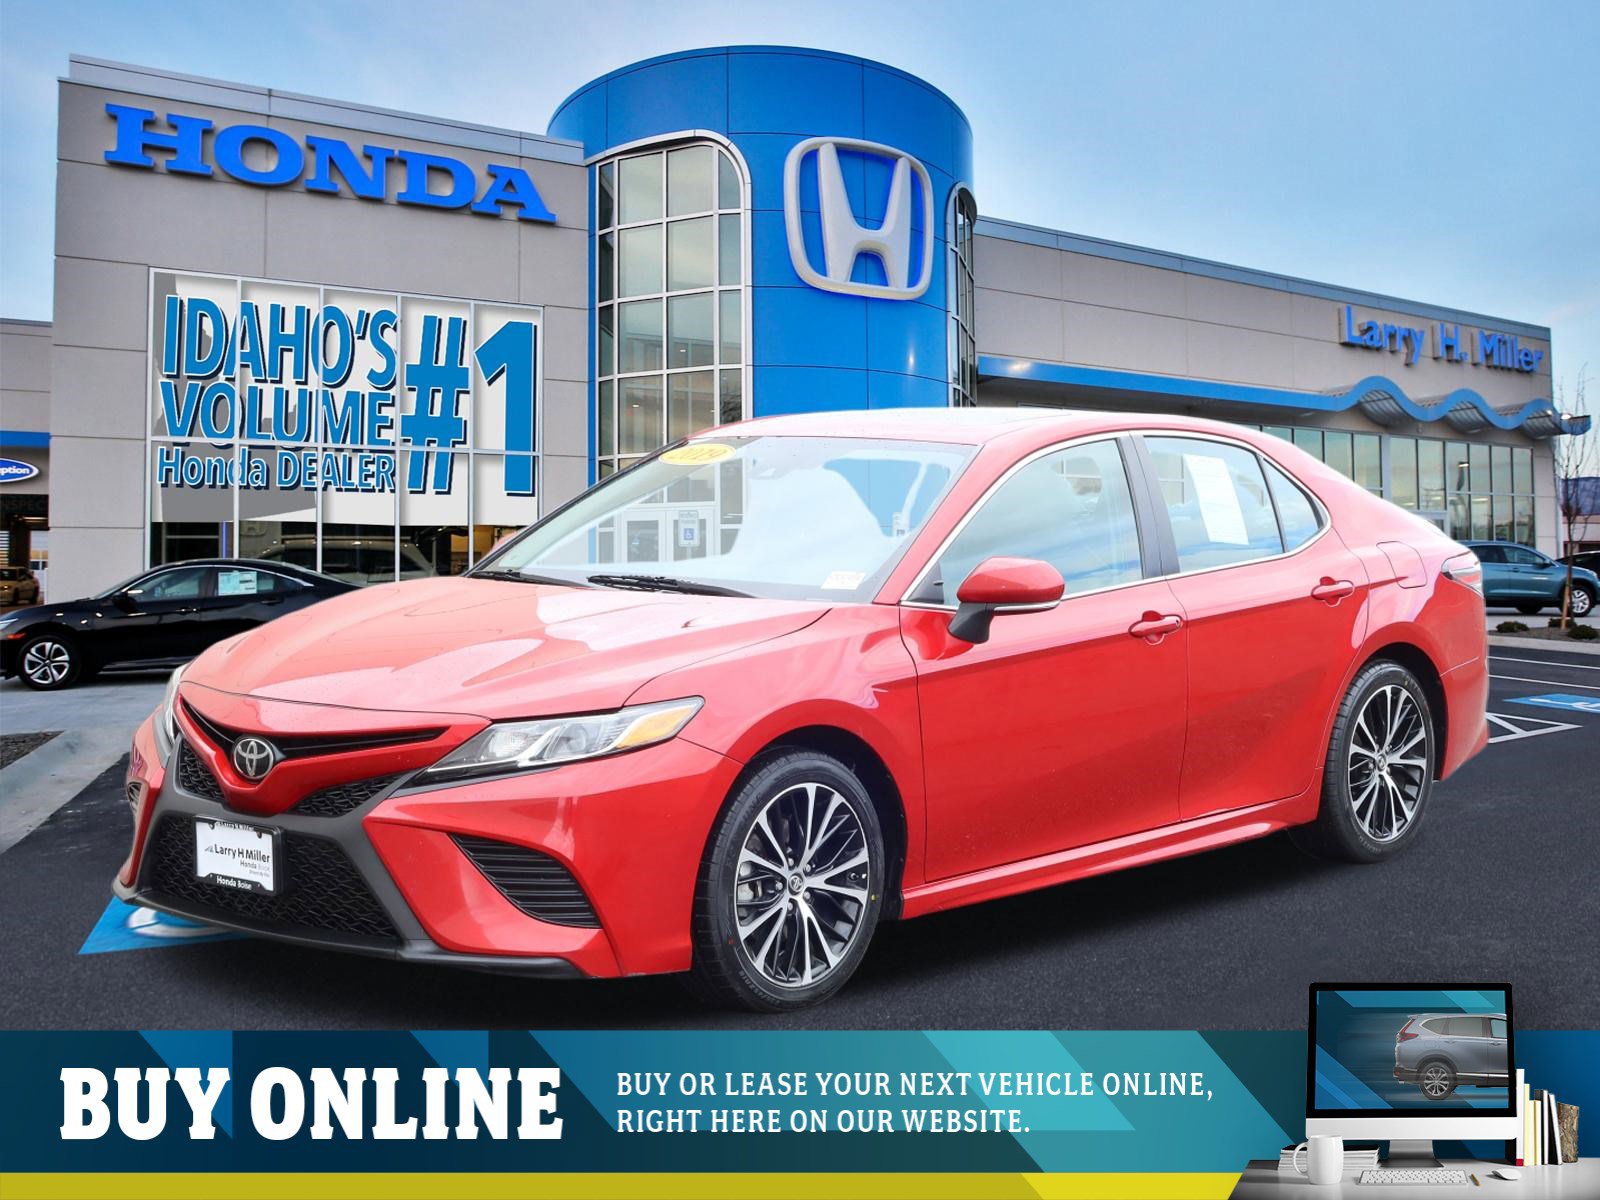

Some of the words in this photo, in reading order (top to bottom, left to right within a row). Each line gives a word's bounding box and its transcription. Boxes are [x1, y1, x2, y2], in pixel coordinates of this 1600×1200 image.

[104, 103, 557, 223] HONDA
[162, 295, 398, 389] IDAHO'S
[1339, 305, 1425, 366] Larry
[1433, 322, 1468, 362] H.
[1473, 330, 1545, 373] Miller
[159, 380, 396, 448] VOLUME
[400, 315, 537, 496] #1
[0, 465, 30, 476] ption
[157, 446, 268, 488] Honda
[276, 451, 396, 492] DEALER
[214, 843, 237, 860] Larry
[238, 847, 245, 859] H
[245, 849, 270, 863] Miller
[240, 859, 257, 870] Honda
[216, 875, 237, 887] Honda
[237, 880, 252, 891] Boise
